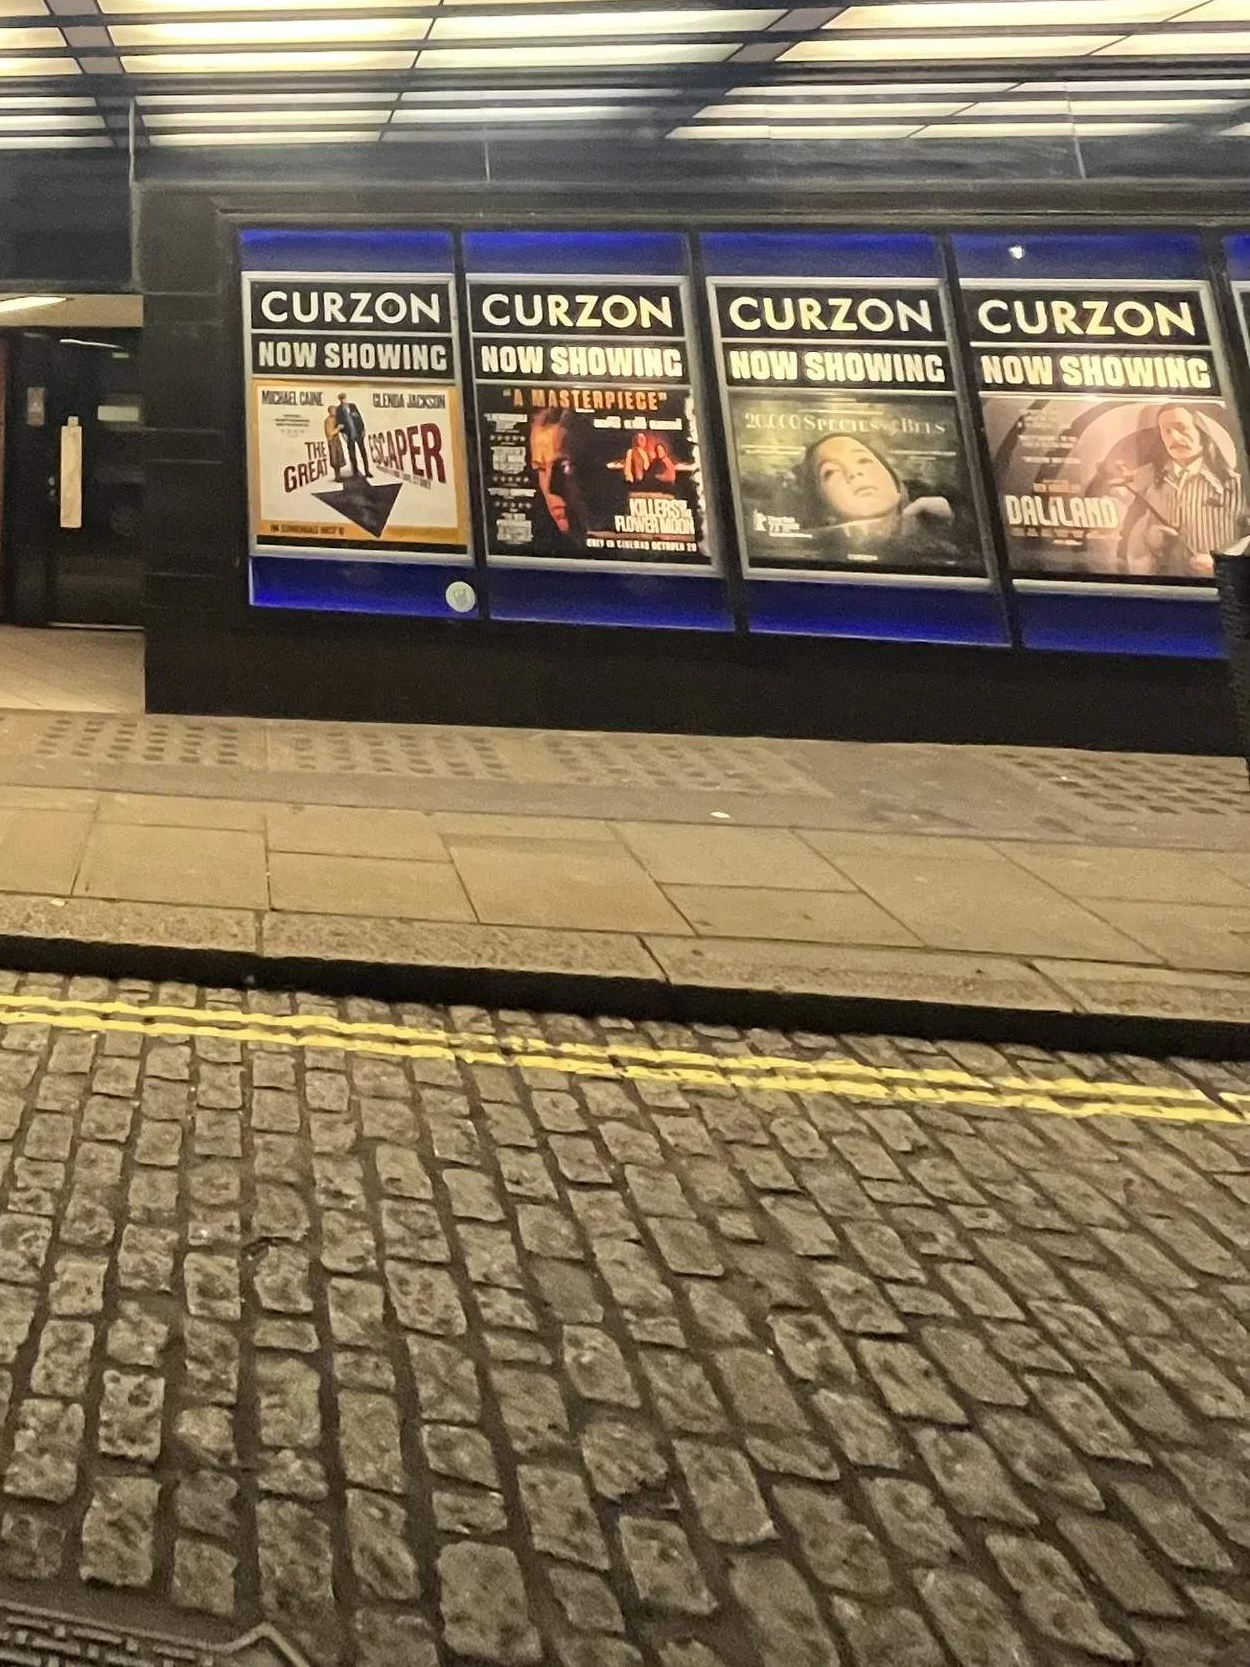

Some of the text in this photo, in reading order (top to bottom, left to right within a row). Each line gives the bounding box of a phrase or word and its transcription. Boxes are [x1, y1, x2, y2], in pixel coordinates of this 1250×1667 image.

[260, 290, 440, 325] CURZON
[482, 293, 673, 329] CURZON
[729, 295, 933, 333] CURZON
[977, 299, 1196, 336] CURZON
[258, 341, 447, 371] NOW SHOWING
[481, 345, 683, 377] NOW SHOWING
[730, 350, 946, 383] NOW SHOWING
[980, 355, 1212, 389] NOW SHOWING
[261, 391, 323, 407] MICHAEL CAINE
[373, 393, 446, 409] GLENDA JACKSON
[304, 441, 328, 460] THE
[367, 422, 447, 484] ESCAPER
[283, 458, 329, 493] GREAT
[629, 498, 679, 519] KILLERS
